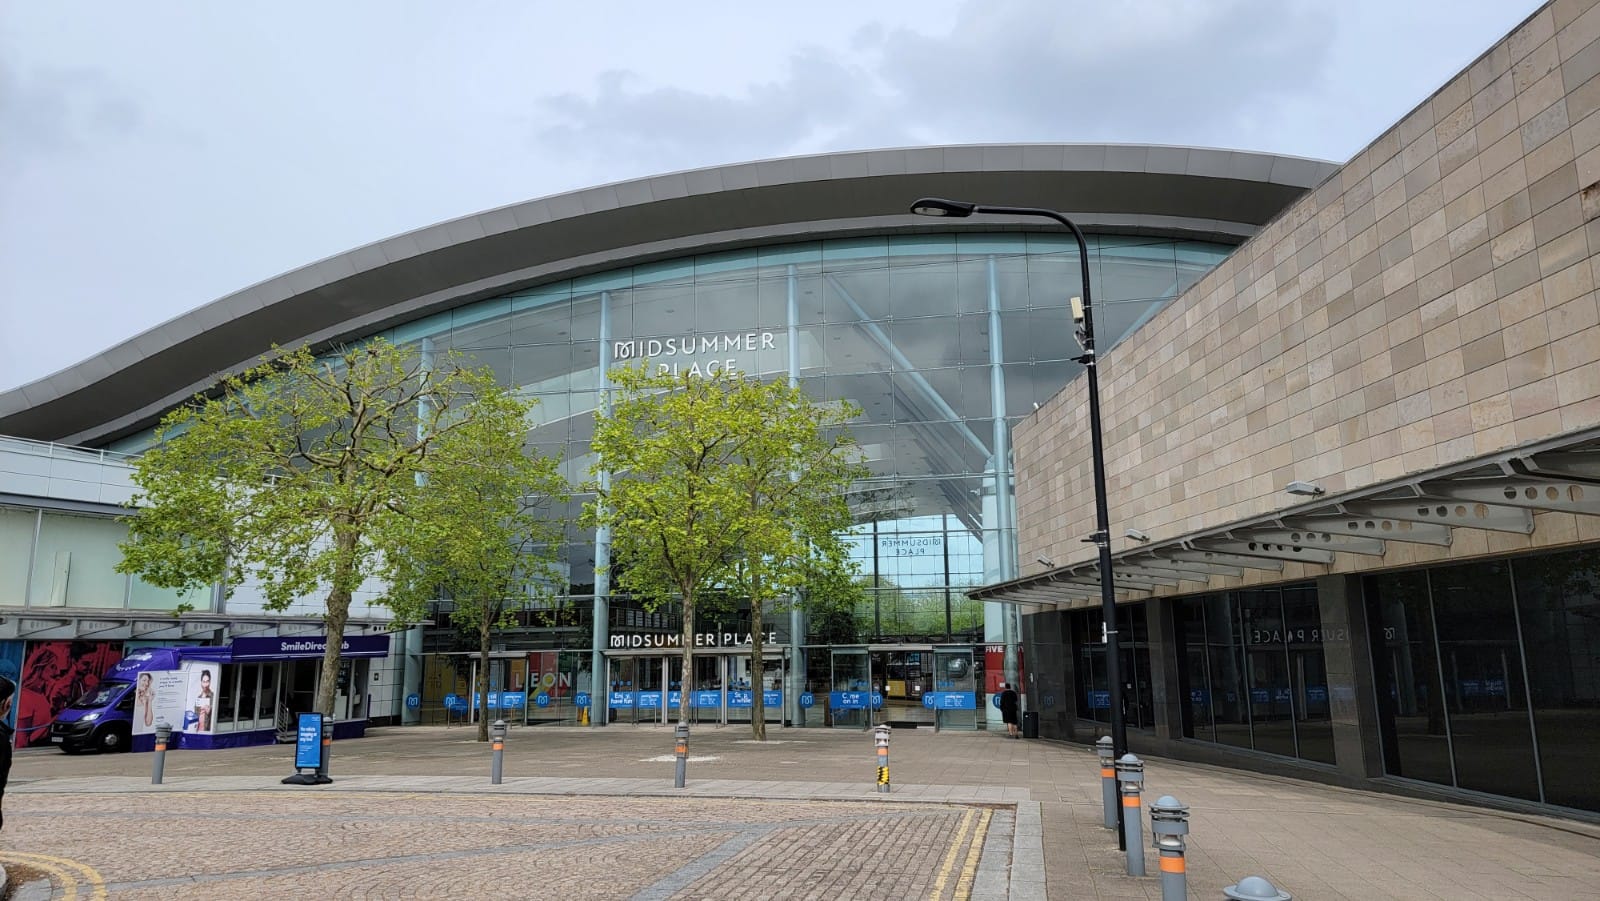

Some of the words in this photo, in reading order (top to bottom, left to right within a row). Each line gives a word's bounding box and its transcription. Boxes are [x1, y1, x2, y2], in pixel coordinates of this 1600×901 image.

[614, 333, 775, 359] MIDSUMMER
[658, 358, 738, 379] PLACE
[281, 641, 350, 651] SmileDirecb
[610, 633, 715, 648] MIDSUMER
[515, 672, 572, 689] LEON
